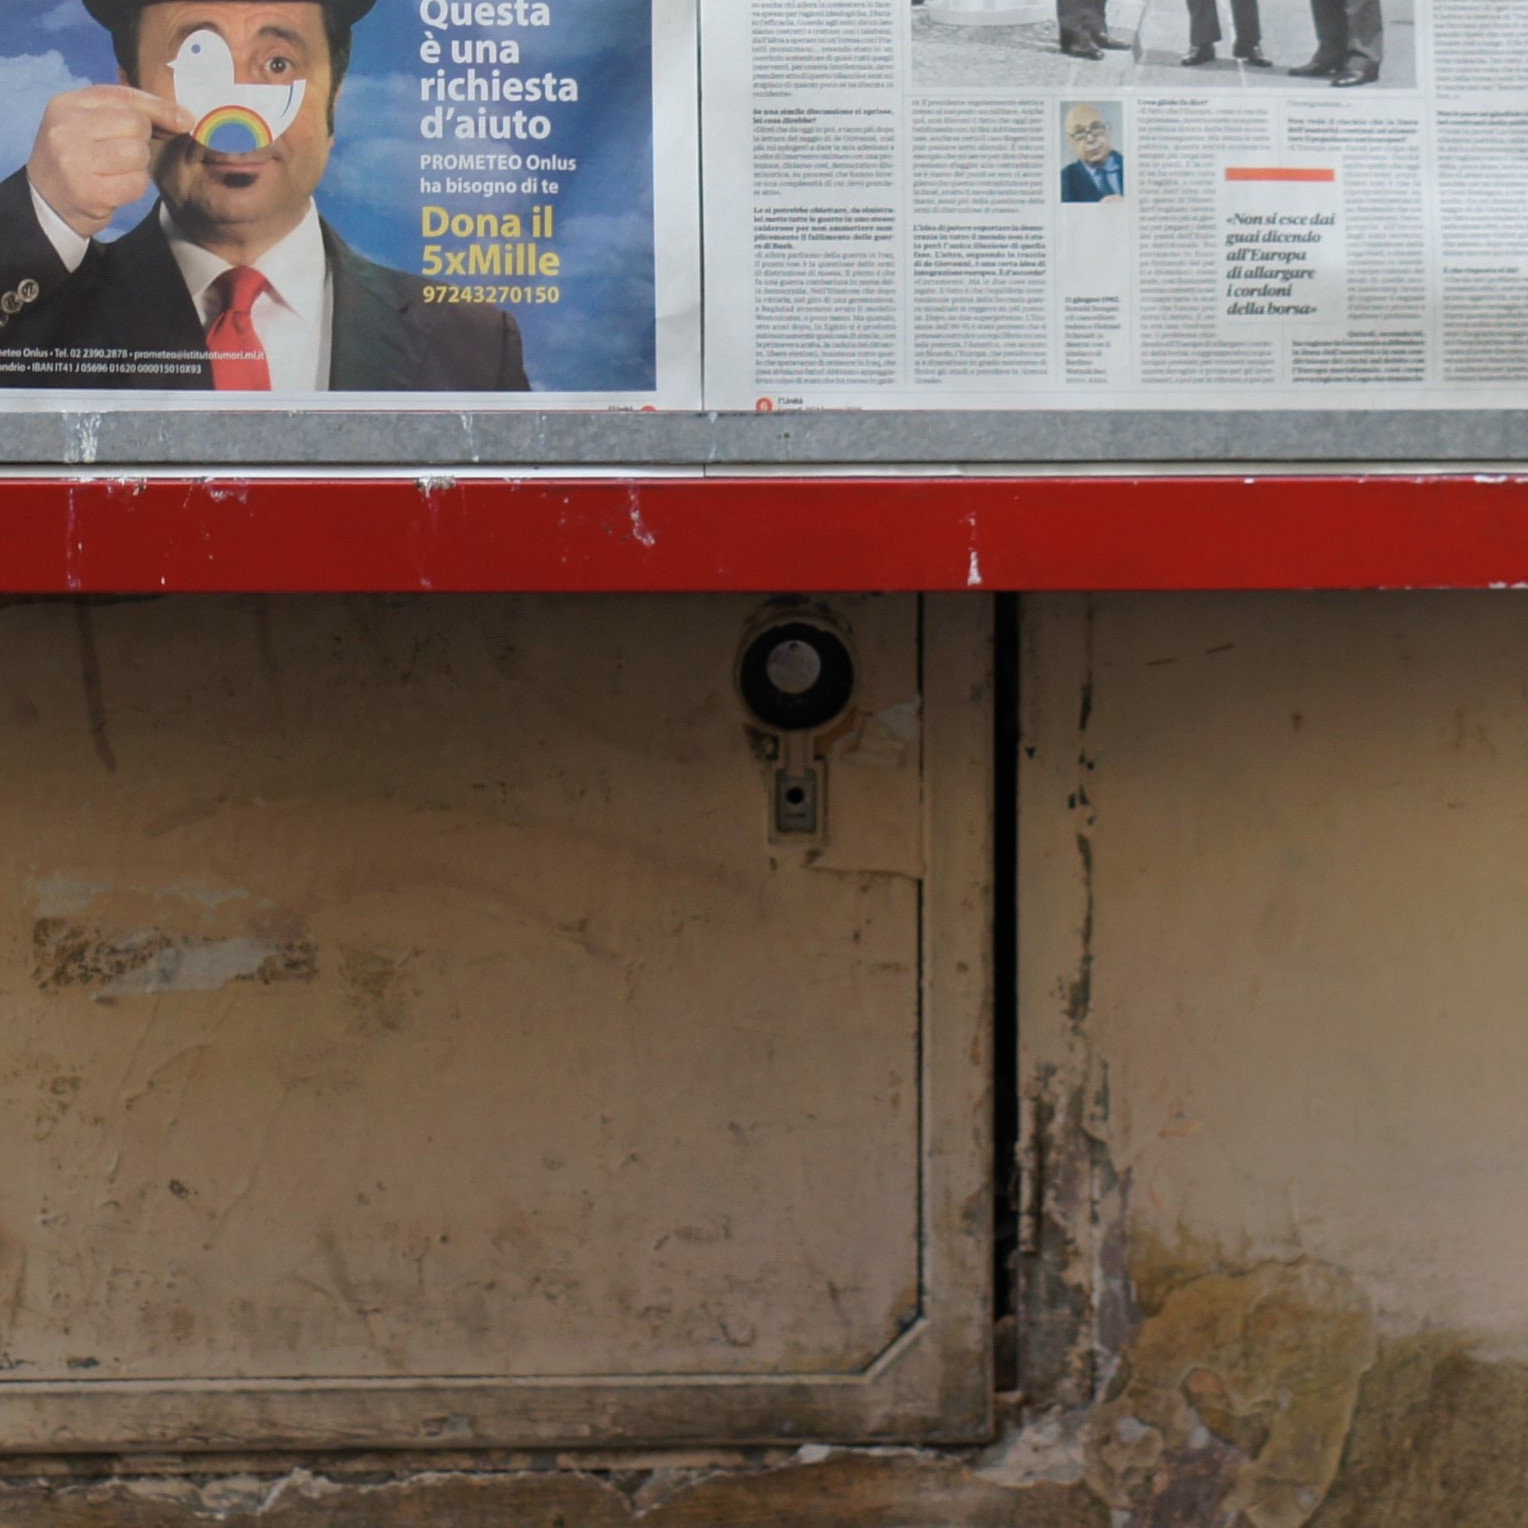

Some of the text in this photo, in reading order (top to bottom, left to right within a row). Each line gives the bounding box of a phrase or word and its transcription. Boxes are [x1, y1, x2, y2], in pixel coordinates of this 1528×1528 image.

[420, 31, 519, 64] è una
[420, 68, 578, 102] richiesta
[420, 154, 576, 171] PROMETEO Onlus
[420, 177, 559, 197] ha bisogno di te
[422, 205, 552, 238] Dona il
[1226, 212, 1335, 226] «Non si esce dai
[1225, 230, 1321, 246] guai dicendo
[422, 243, 560, 276] 5xMille
[1226, 266, 1315, 282] di allargare
[423, 284, 560, 304] 97243270150
[1226, 284, 1292, 297] i cordoni
[1227, 302, 1317, 315] della borsa»
